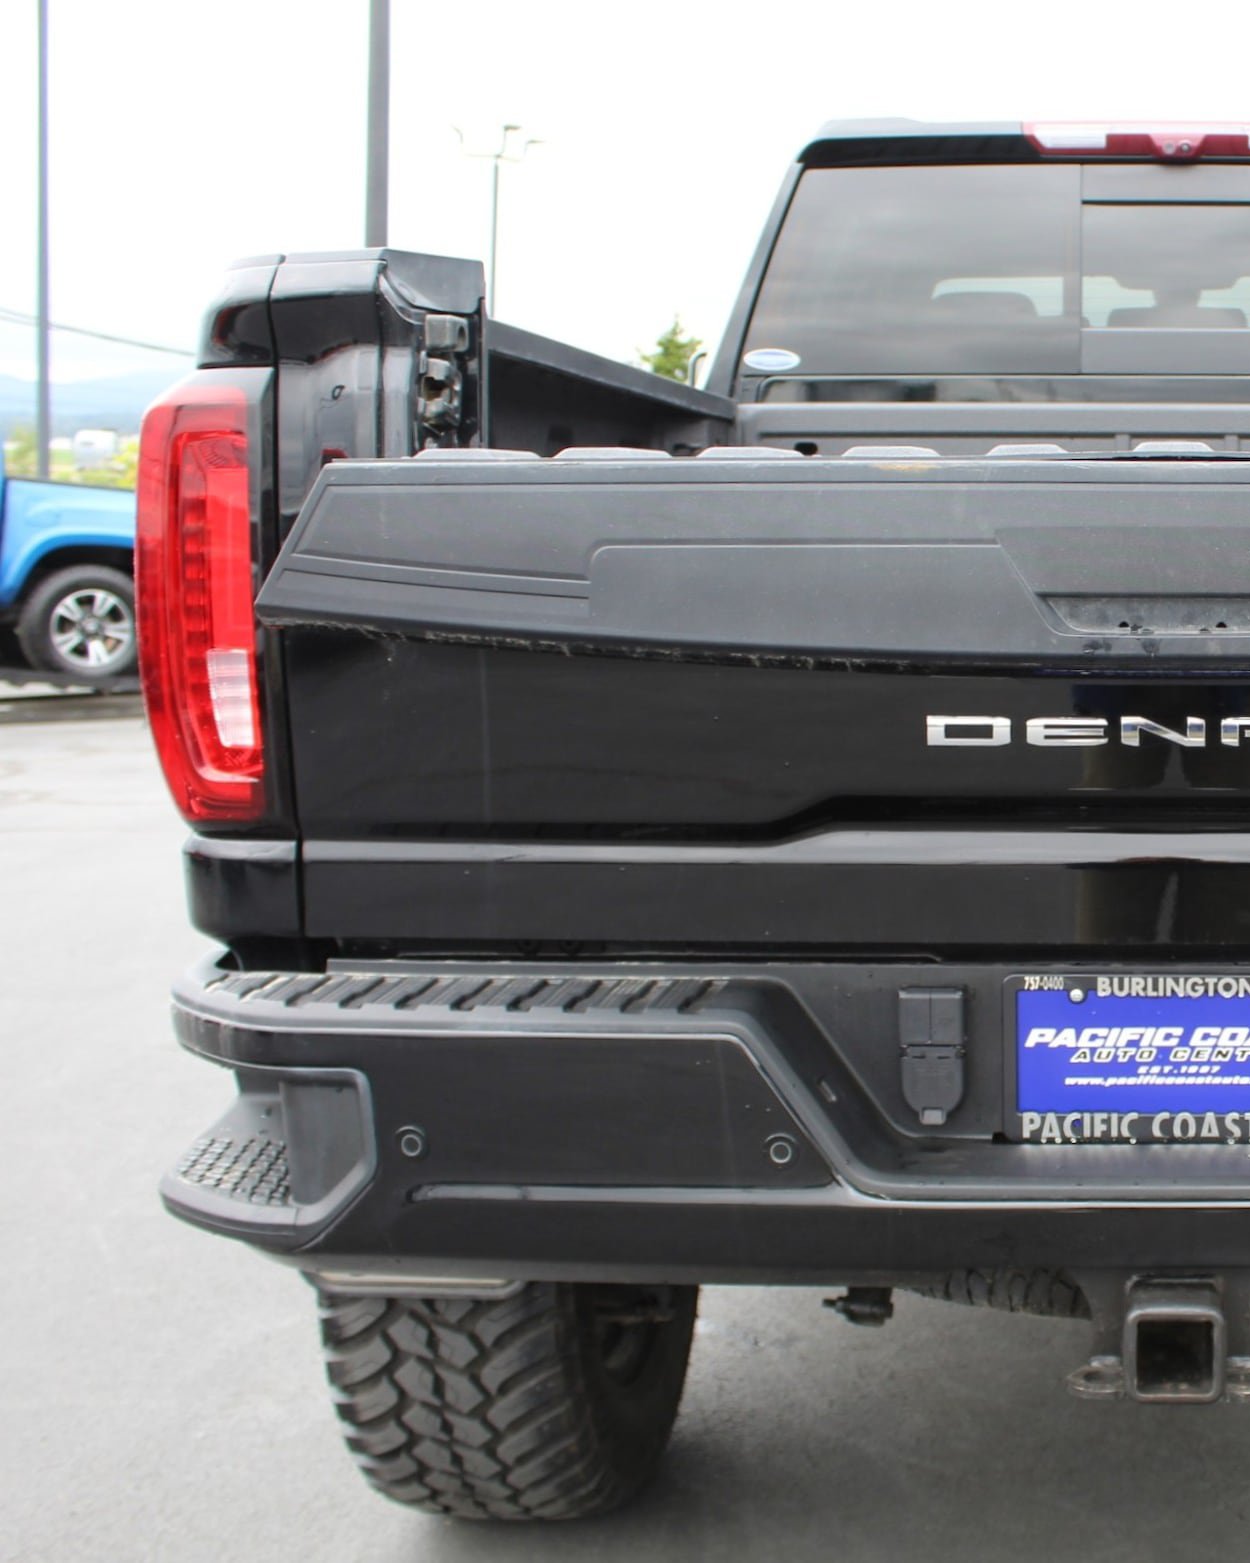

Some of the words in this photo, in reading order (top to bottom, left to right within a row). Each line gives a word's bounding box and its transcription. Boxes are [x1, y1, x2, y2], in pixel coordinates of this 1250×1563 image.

[1023, 976, 1064, 991] 757-0400
[1024, 1027, 1184, 1049] PACIFIC
[1069, 1046, 1157, 1063] AUTO
[1021, 1111, 1140, 1139] PACIFIC
